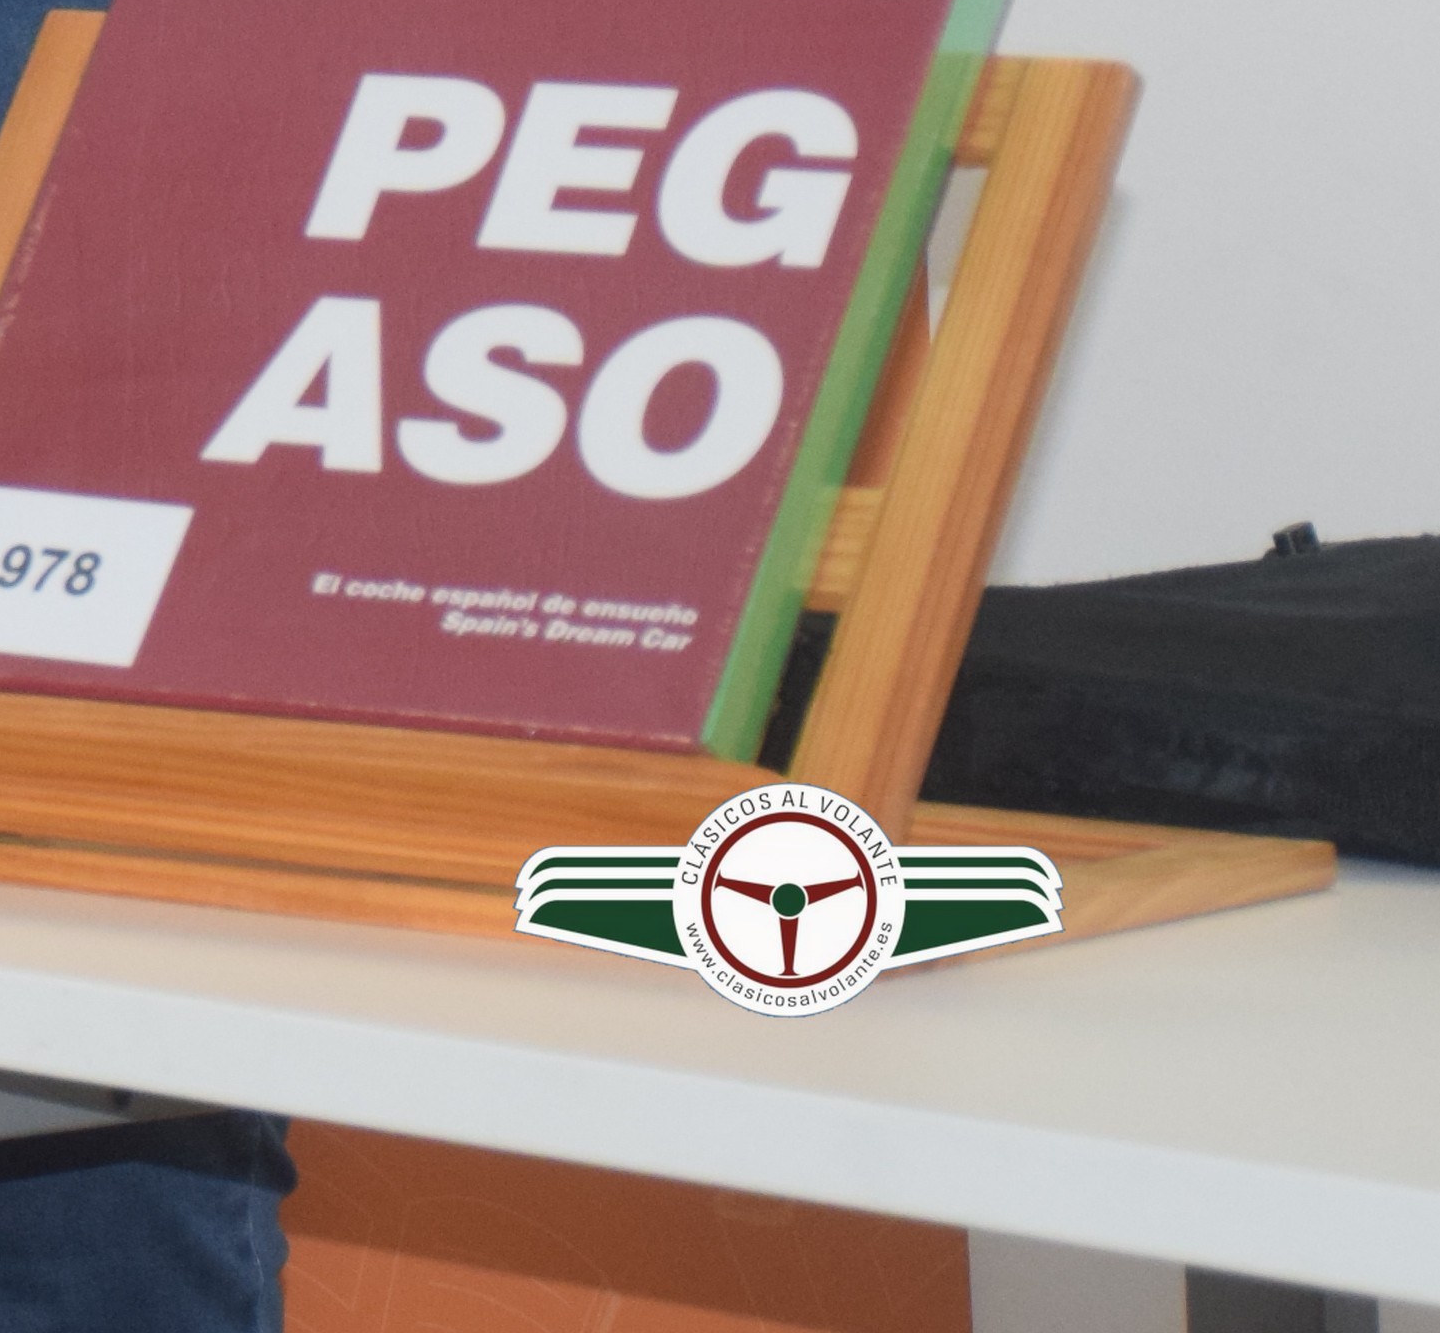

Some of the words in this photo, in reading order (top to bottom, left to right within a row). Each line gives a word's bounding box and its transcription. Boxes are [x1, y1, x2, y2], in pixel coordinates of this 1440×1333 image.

[304, 72, 859, 269] PEG
[199, 296, 785, 500] ASO
[312, 572, 343, 595] El
[344, 578, 426, 603] coche
[430, 586, 539, 613] español
[541, 593, 577, 616] de
[582, 600, 699, 626] ensueño
[440, 610, 540, 639] Spain's
[543, 620, 635, 647] Dream
[640, 628, 694, 652] Car
